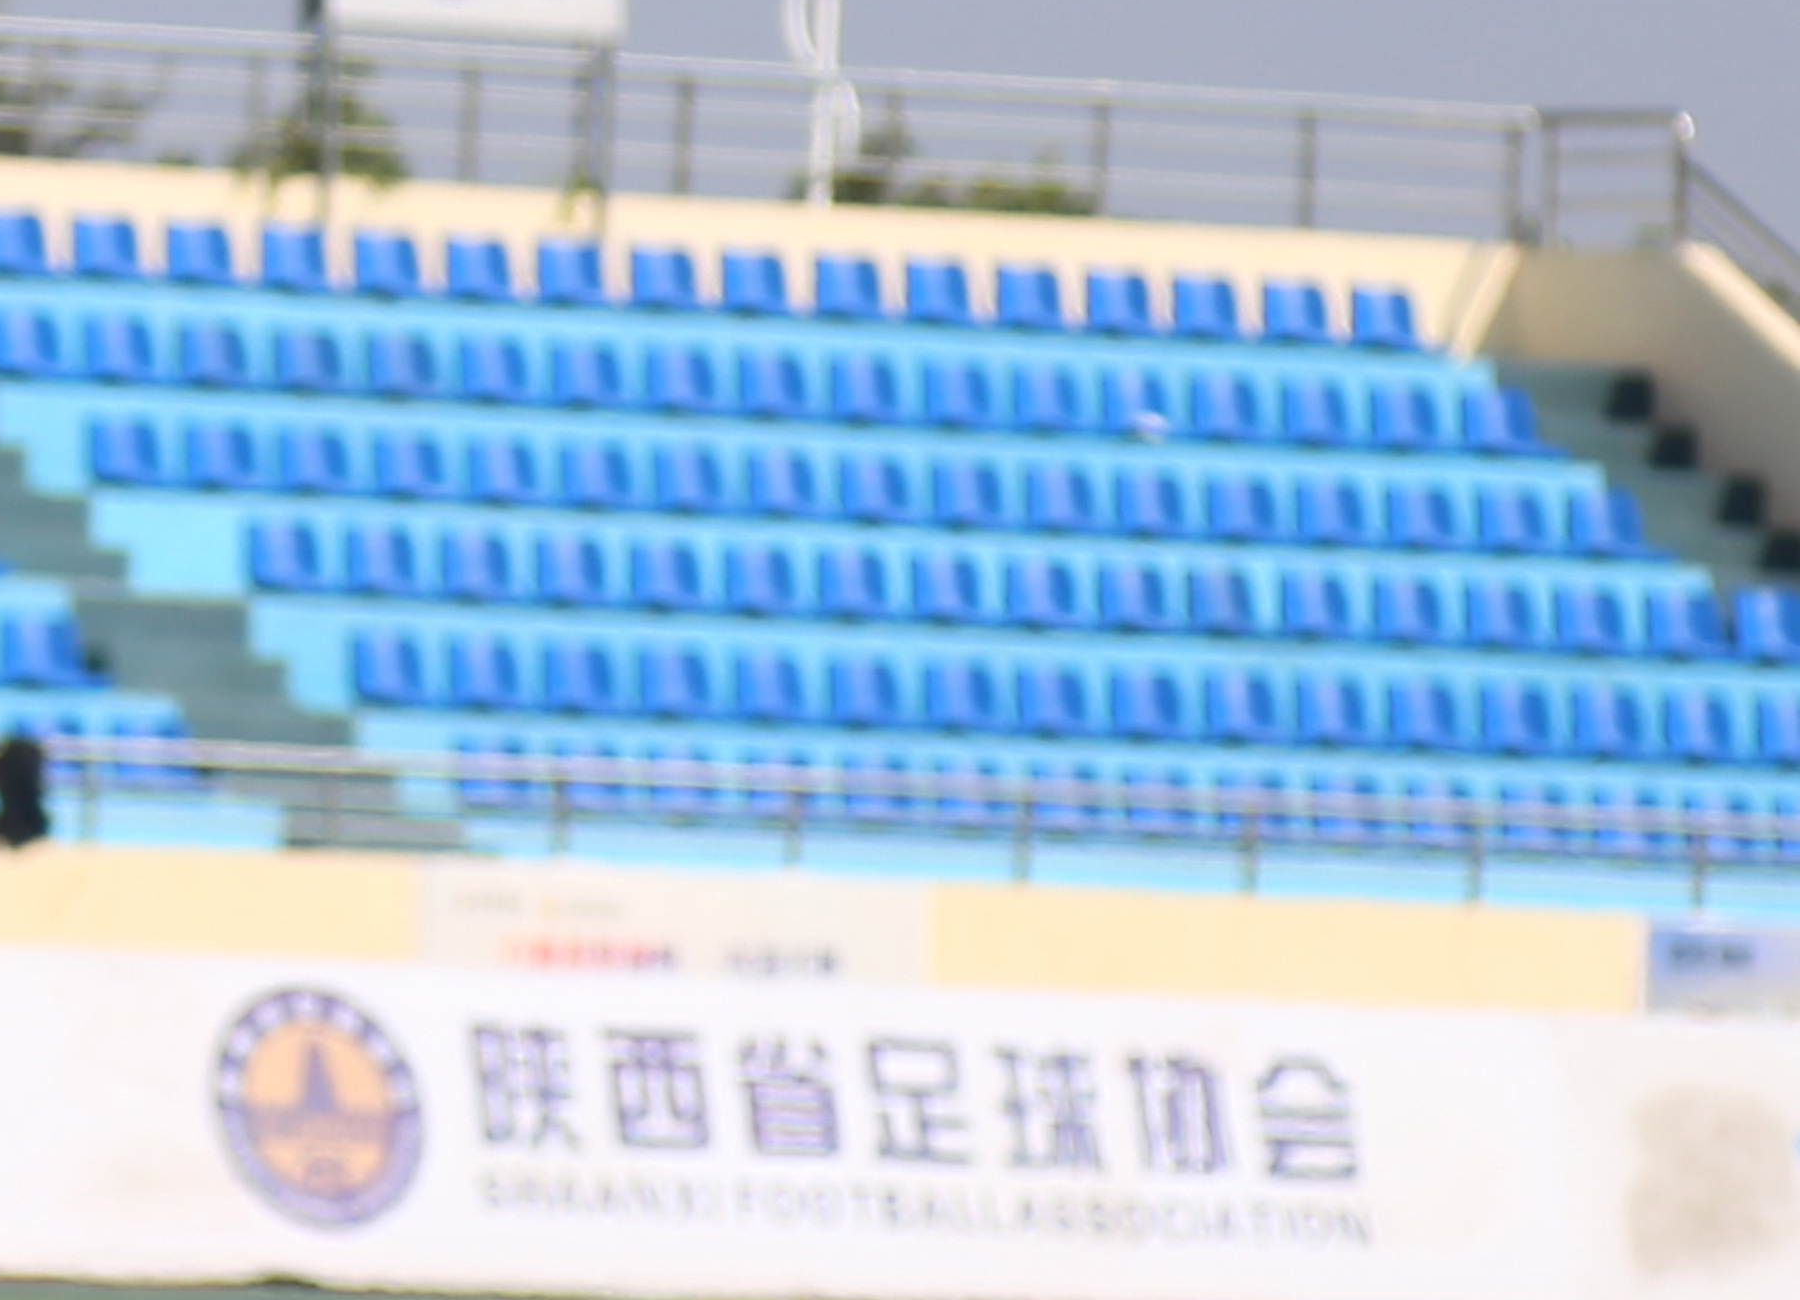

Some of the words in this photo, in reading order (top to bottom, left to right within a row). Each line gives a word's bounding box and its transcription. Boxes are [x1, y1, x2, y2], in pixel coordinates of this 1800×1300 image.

[472, 1020, 1360, 1182] 陕西省足球协会
